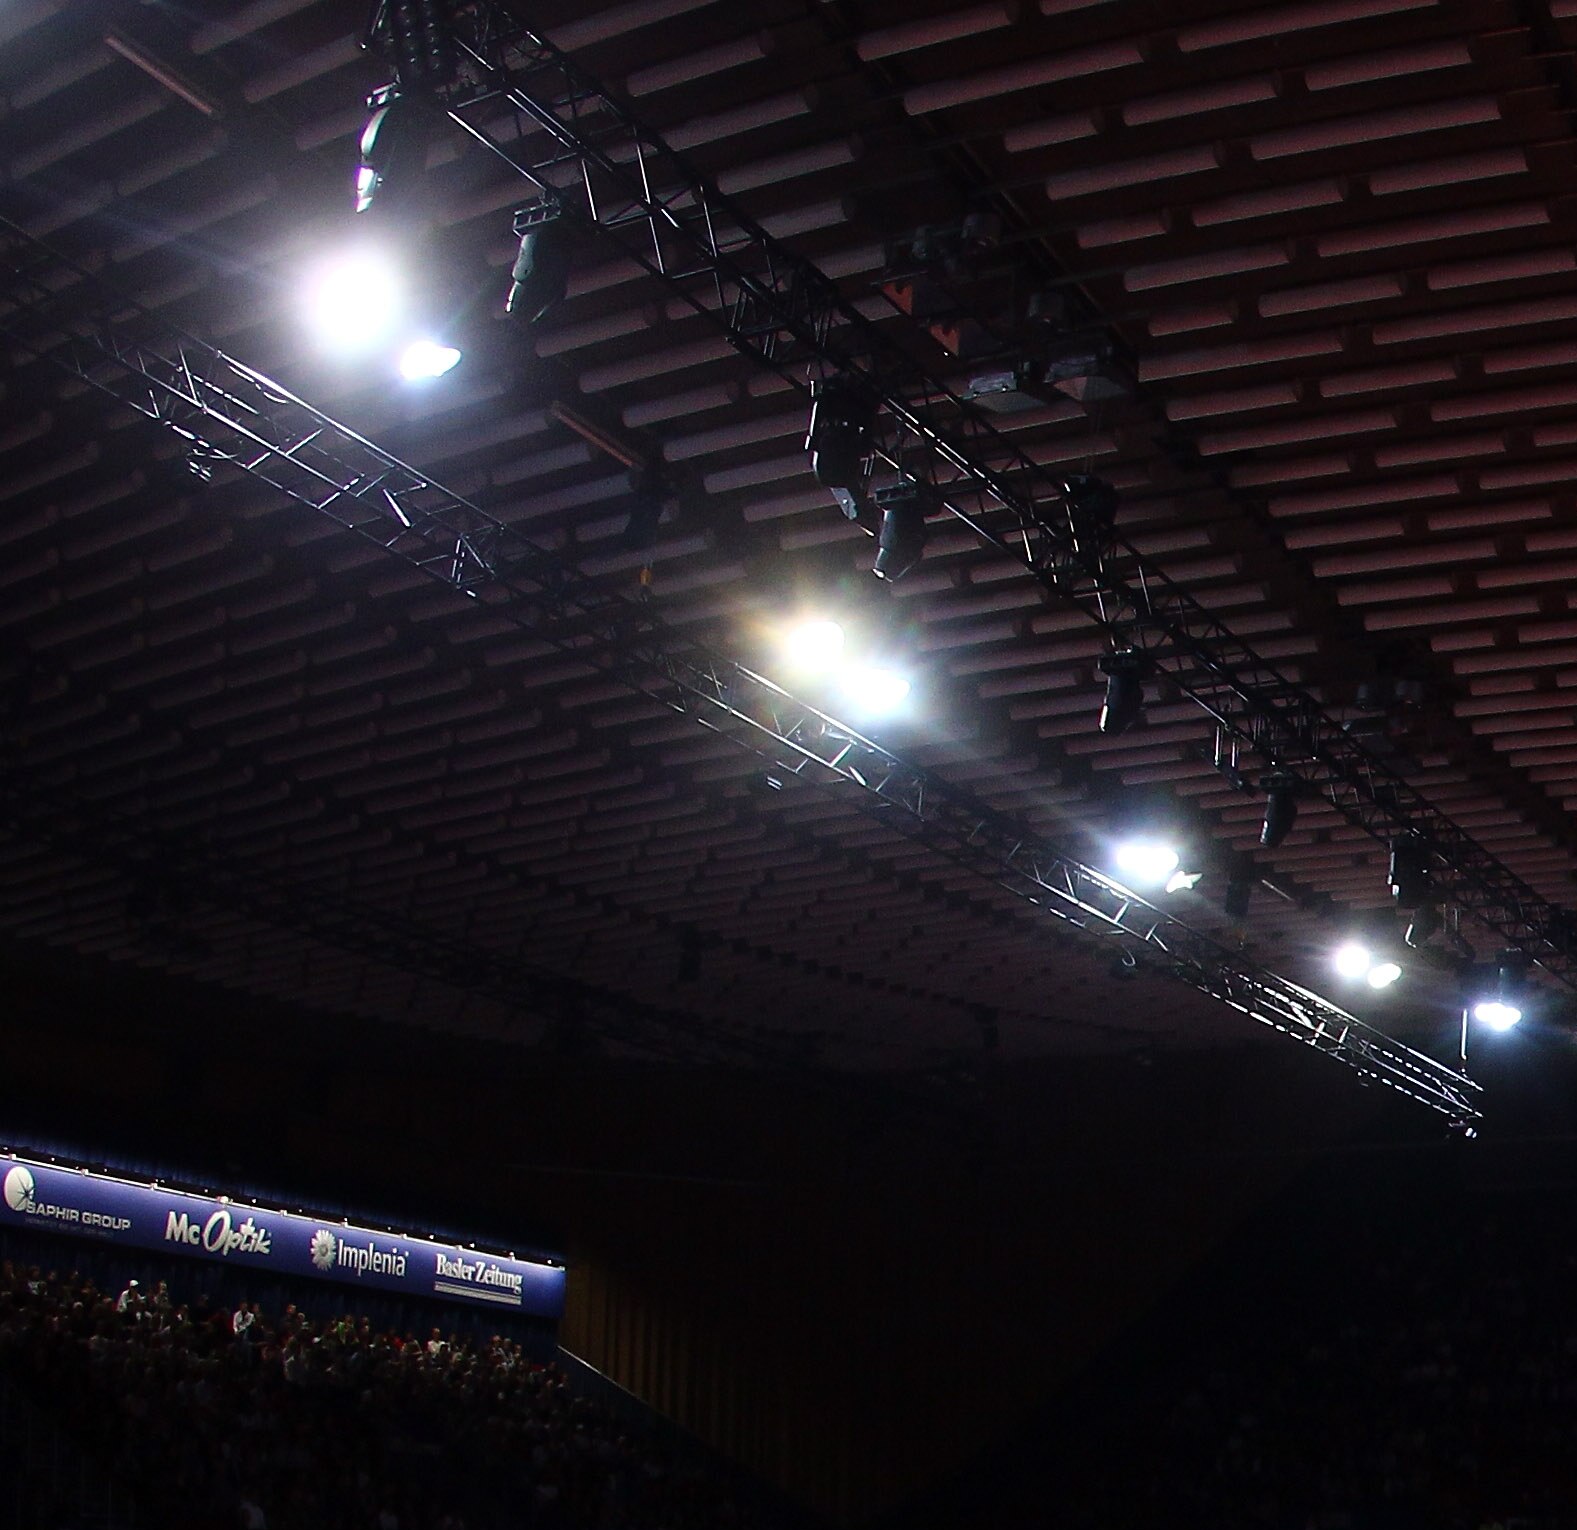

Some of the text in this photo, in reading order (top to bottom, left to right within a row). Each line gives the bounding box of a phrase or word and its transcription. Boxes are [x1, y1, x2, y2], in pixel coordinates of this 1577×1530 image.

[25, 1201, 80, 1224] SAPHIR
[81, 1211, 132, 1231] GROUP
[338, 1239, 406, 1277] Implenia
[436, 1254, 523, 1295] Basler Zeitung
